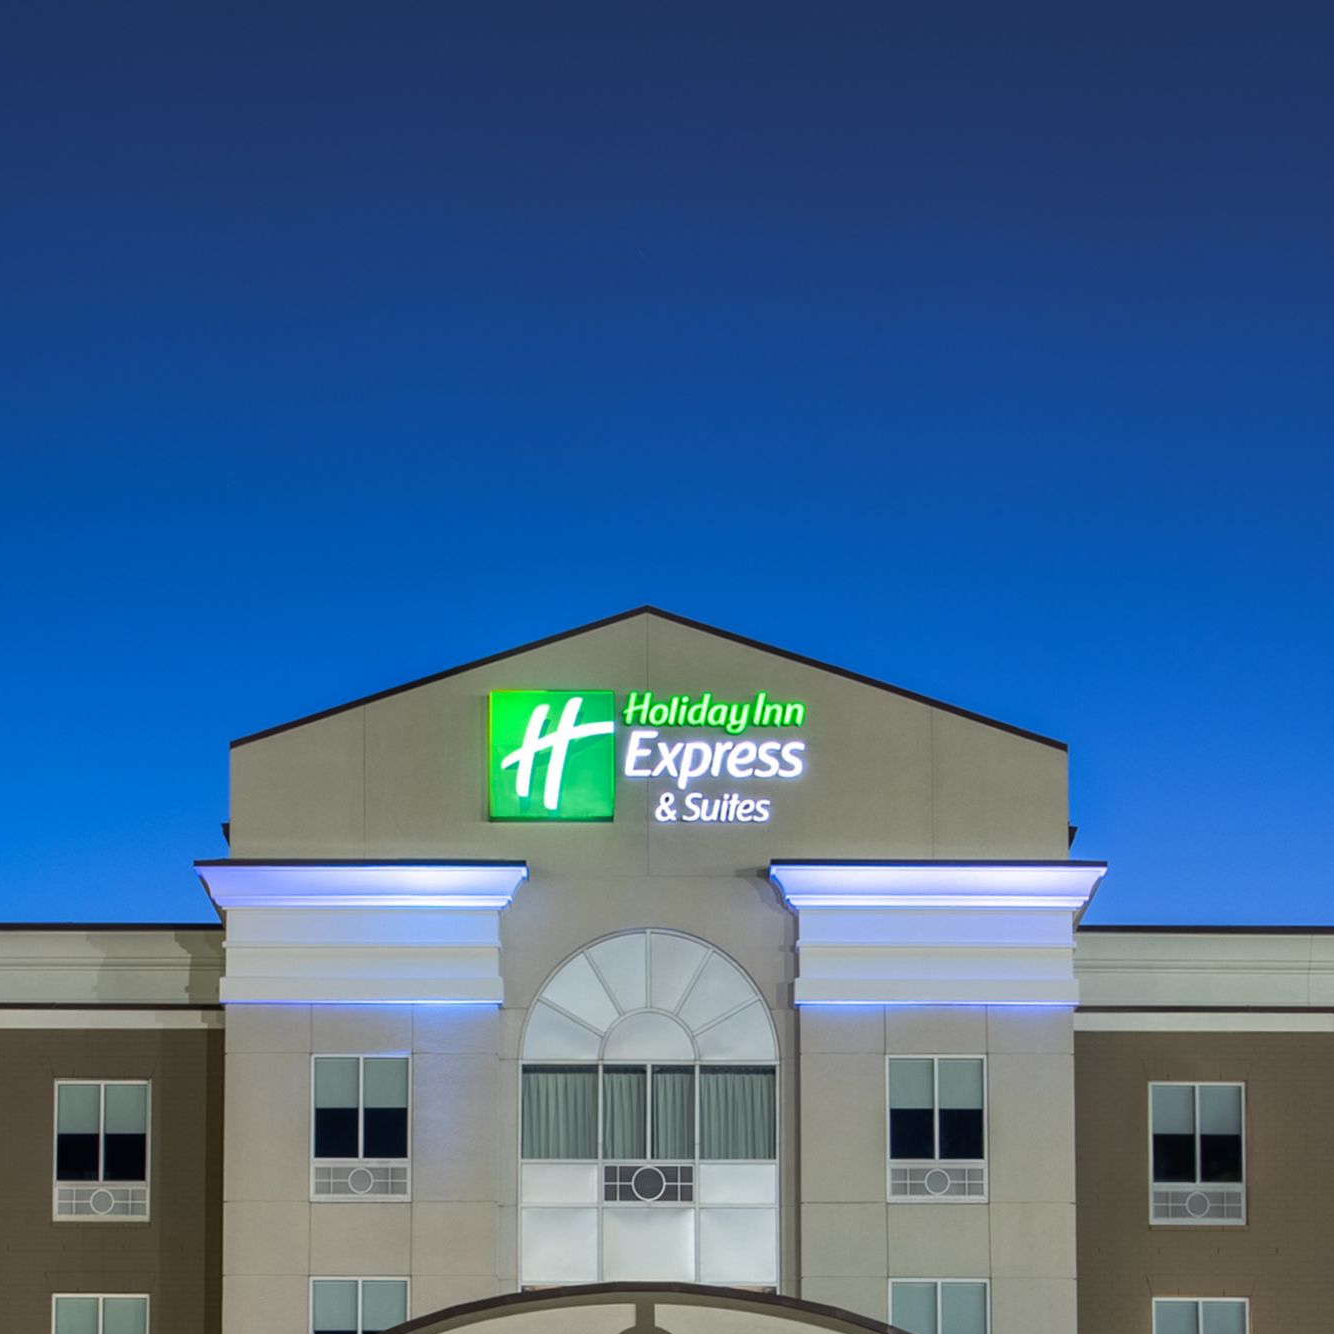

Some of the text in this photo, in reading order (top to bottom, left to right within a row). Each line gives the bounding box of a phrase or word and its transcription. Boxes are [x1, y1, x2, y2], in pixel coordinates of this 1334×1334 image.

[623, 691, 806, 734] Holiday Inn
[500, 696, 615, 811] H
[624, 730, 806, 790] Express
[654, 792, 771, 822] & Suites
